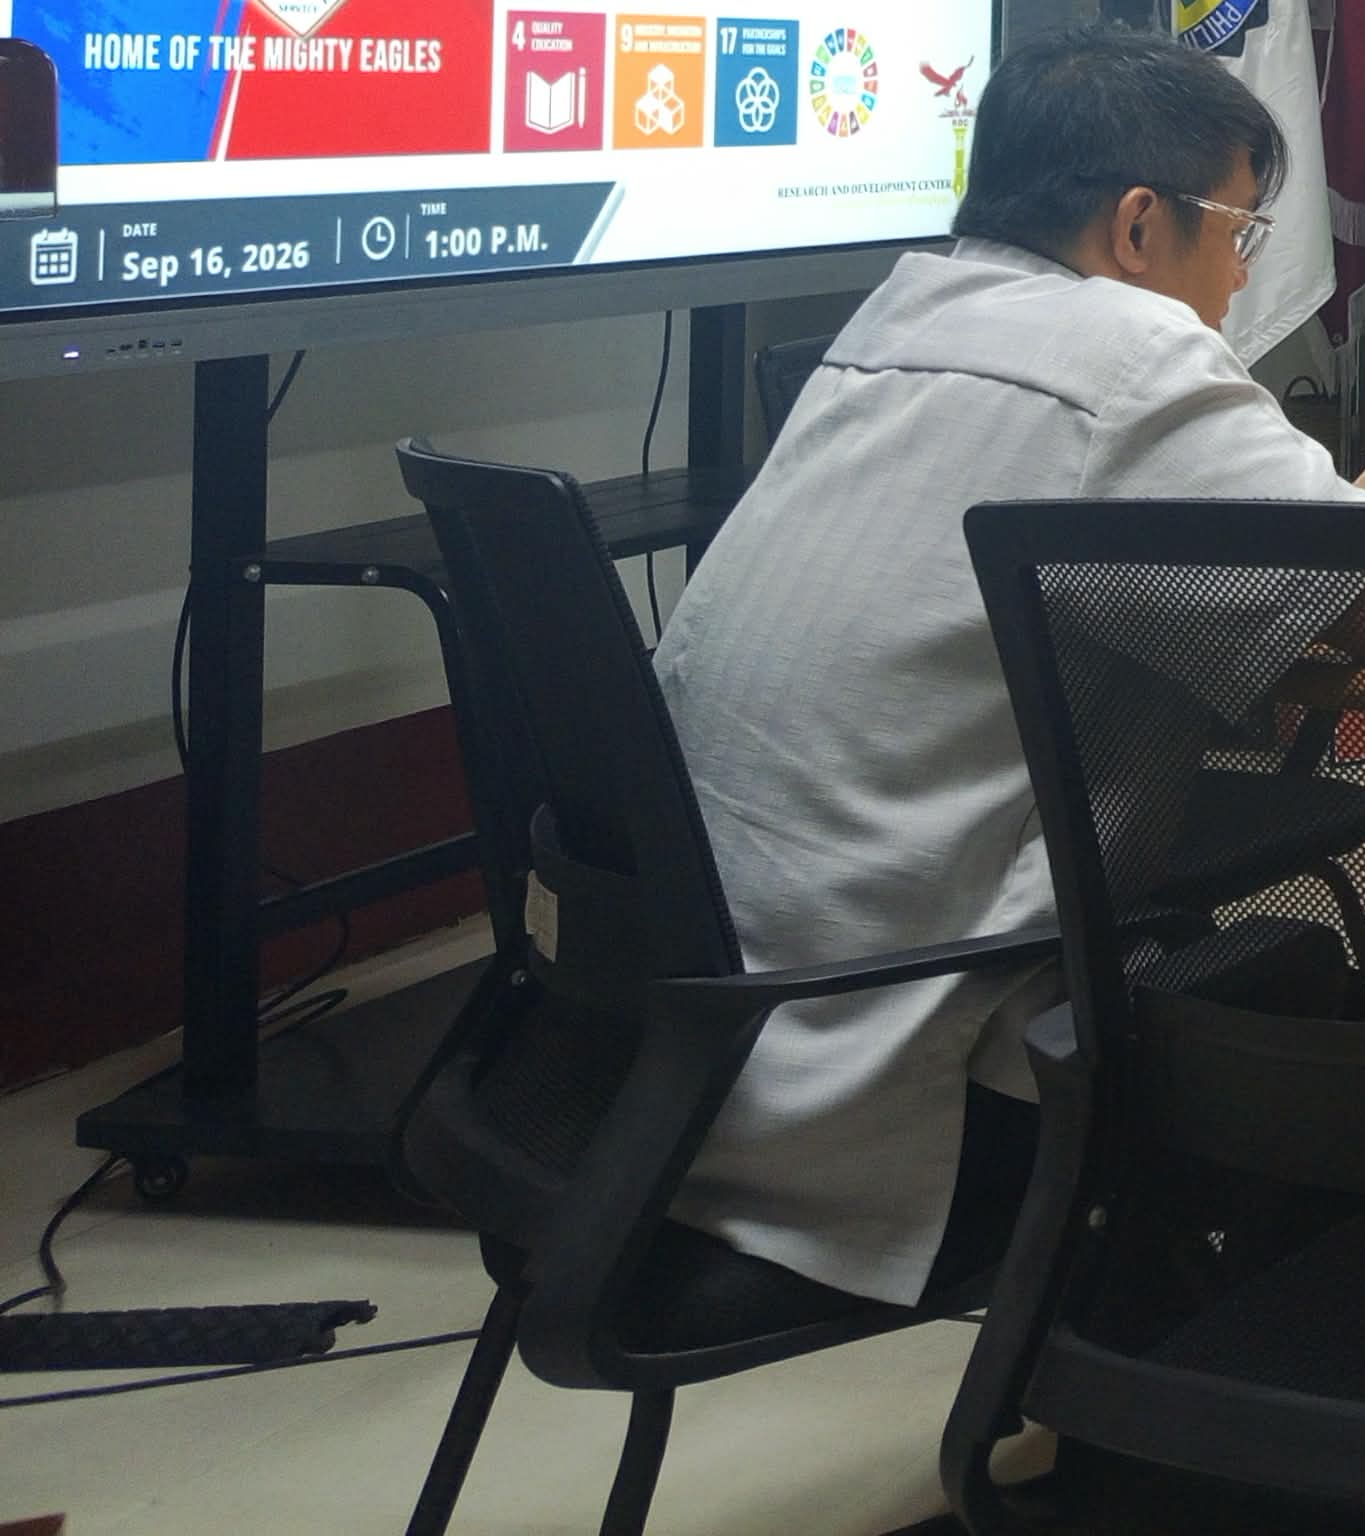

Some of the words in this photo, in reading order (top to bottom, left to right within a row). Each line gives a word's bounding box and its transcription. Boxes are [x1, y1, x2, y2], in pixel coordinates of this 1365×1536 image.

[512, 20, 526, 52] 4
[620, 23, 633, 53] 9
[720, 27, 738, 56] 17
[85, 34, 160, 71] HOME
[169, 34, 200, 70] OF
[209, 35, 256, 72] THE
[263, 37, 352, 72] MIGHTY
[360, 39, 442, 73] EAGLES
[778, 184, 828, 199] RESEARCH
[832, 183, 850, 195] AND
[851, 180, 916, 195] DEVELOPMENT
[918, 178, 952, 191] CENTER
[420, 202, 447, 216] TIME
[122, 222, 158, 238] DATE
[425, 227, 482, 260] 1:00
[490, 223, 549, 255] P.M.
[121, 251, 179, 286] Sep
[189, 247, 233, 281] 16,
[242, 241, 310, 274] 2026
